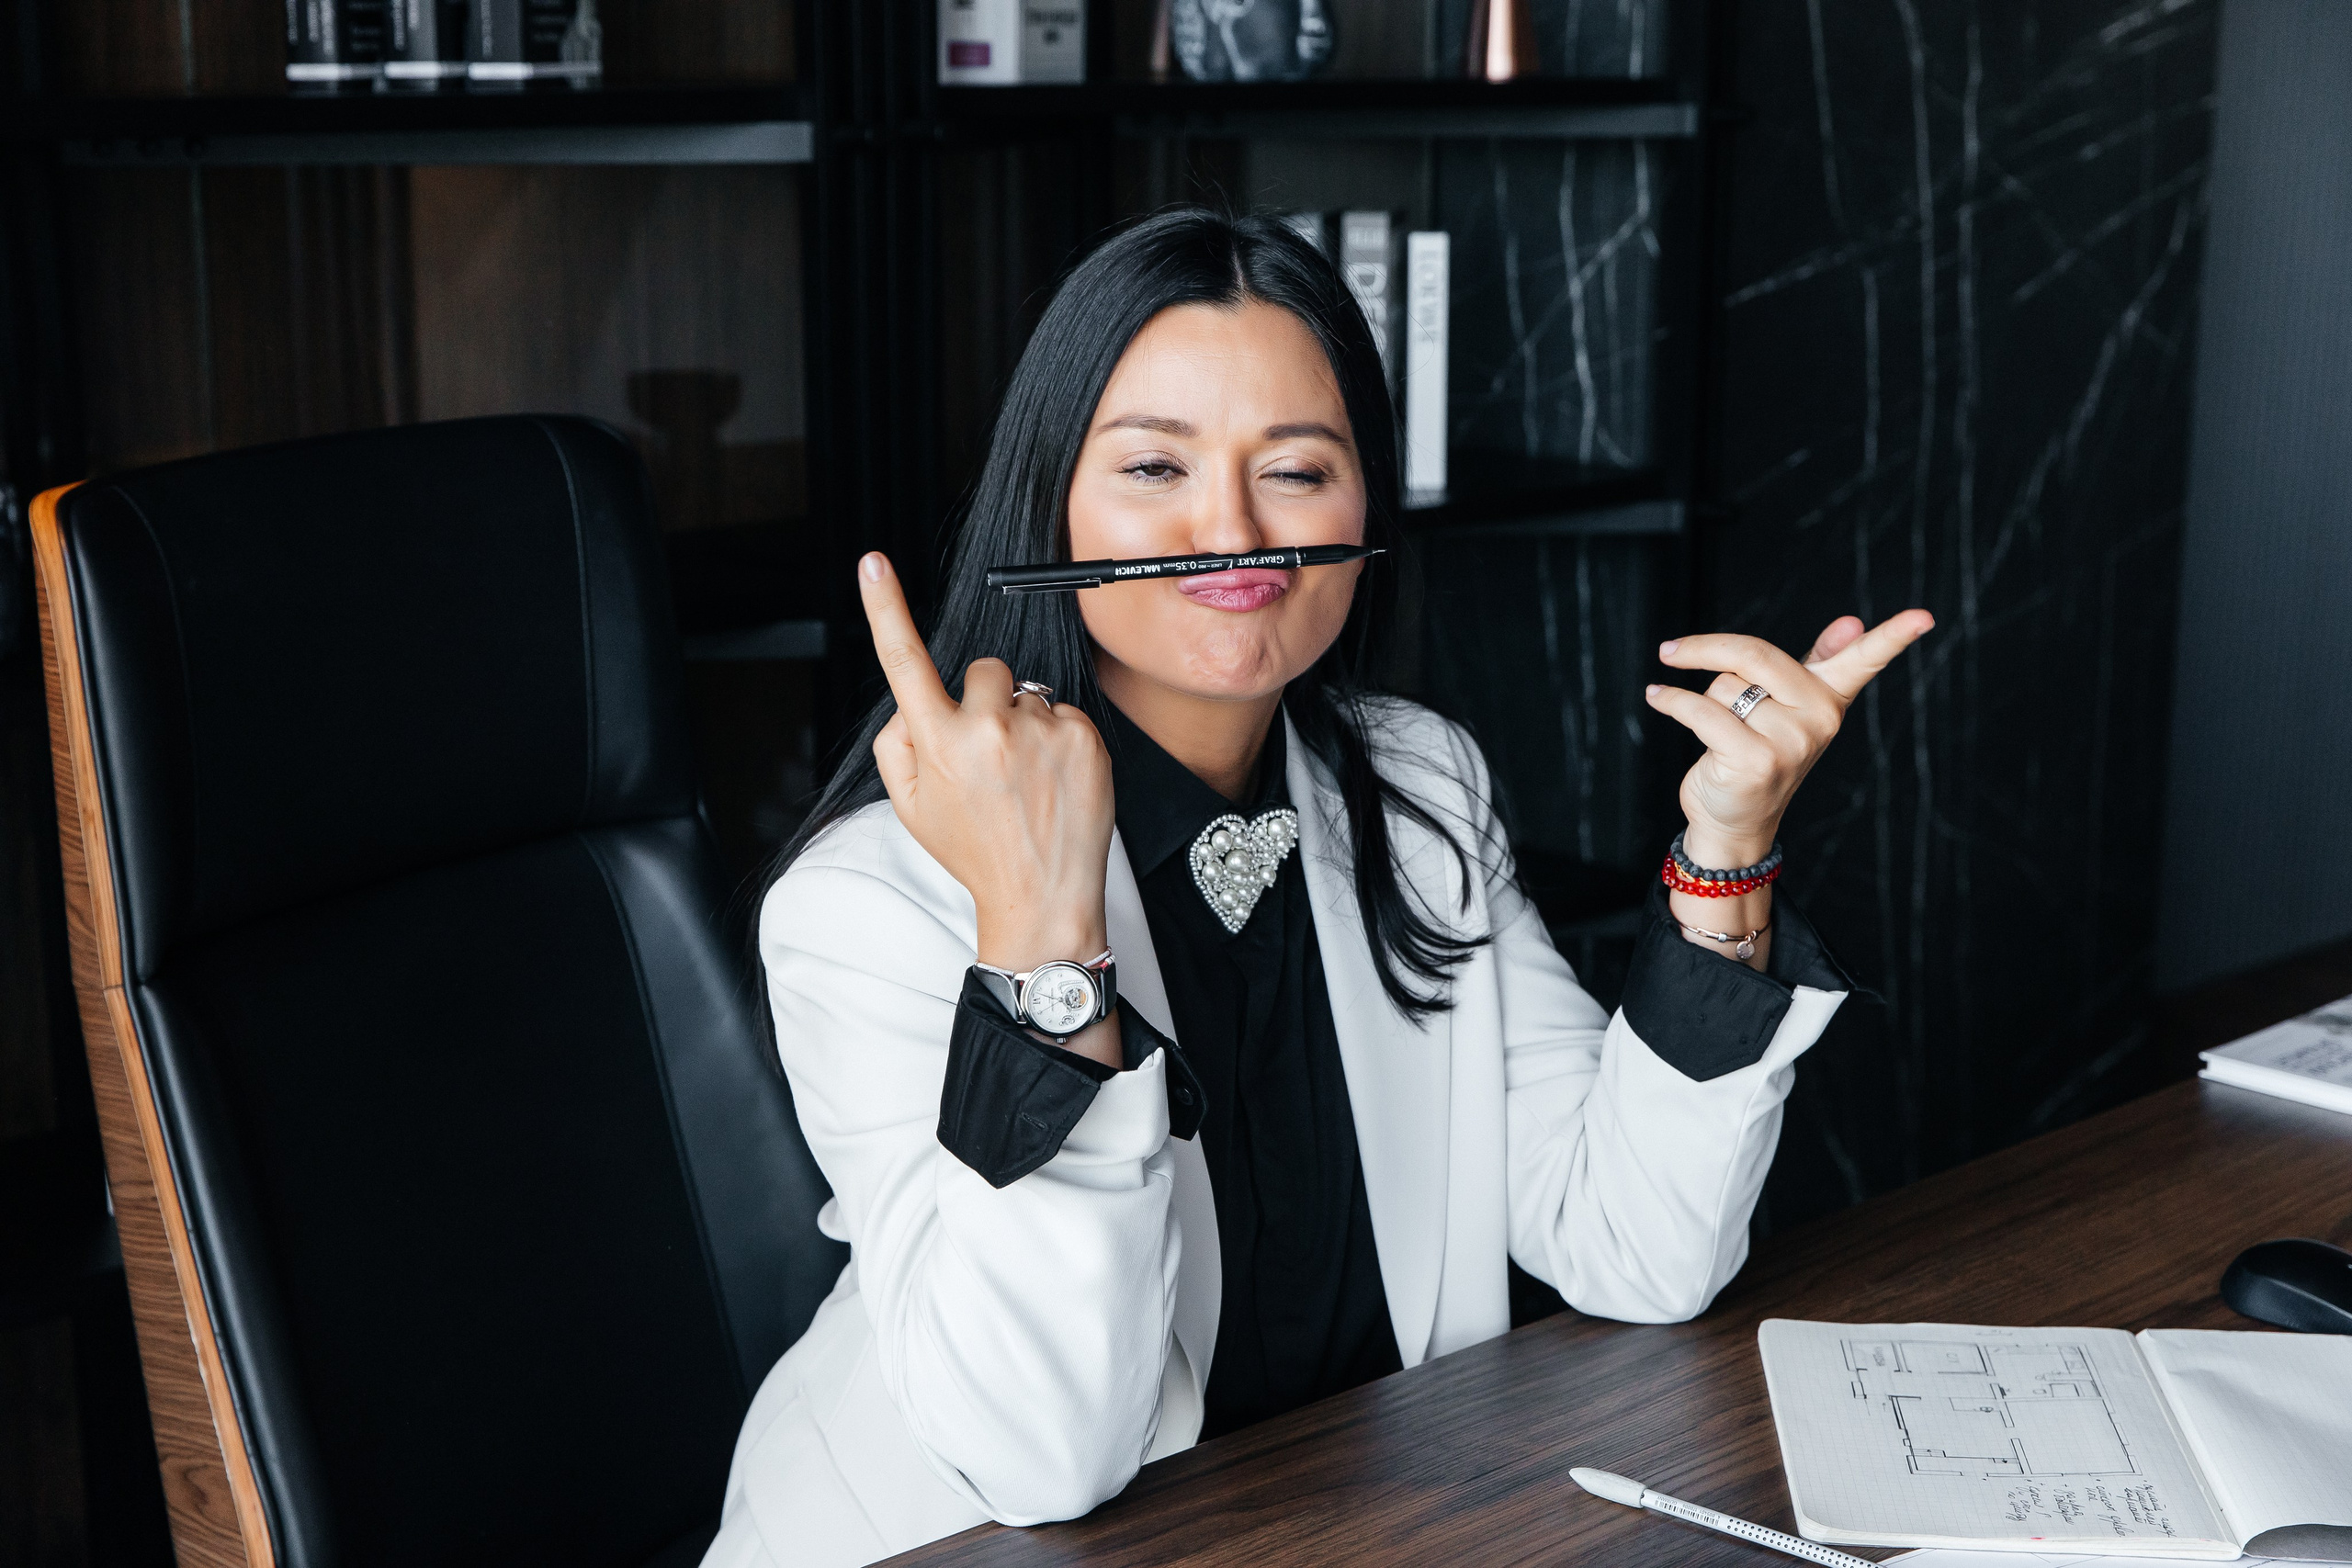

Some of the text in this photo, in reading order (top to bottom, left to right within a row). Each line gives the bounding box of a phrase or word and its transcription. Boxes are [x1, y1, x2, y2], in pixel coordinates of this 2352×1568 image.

[1163, 561, 1196, 571] 0.35mm
[1238, 555, 1284, 566] GRAF'ART
[1115, 564, 1160, 576] MALEVICH
